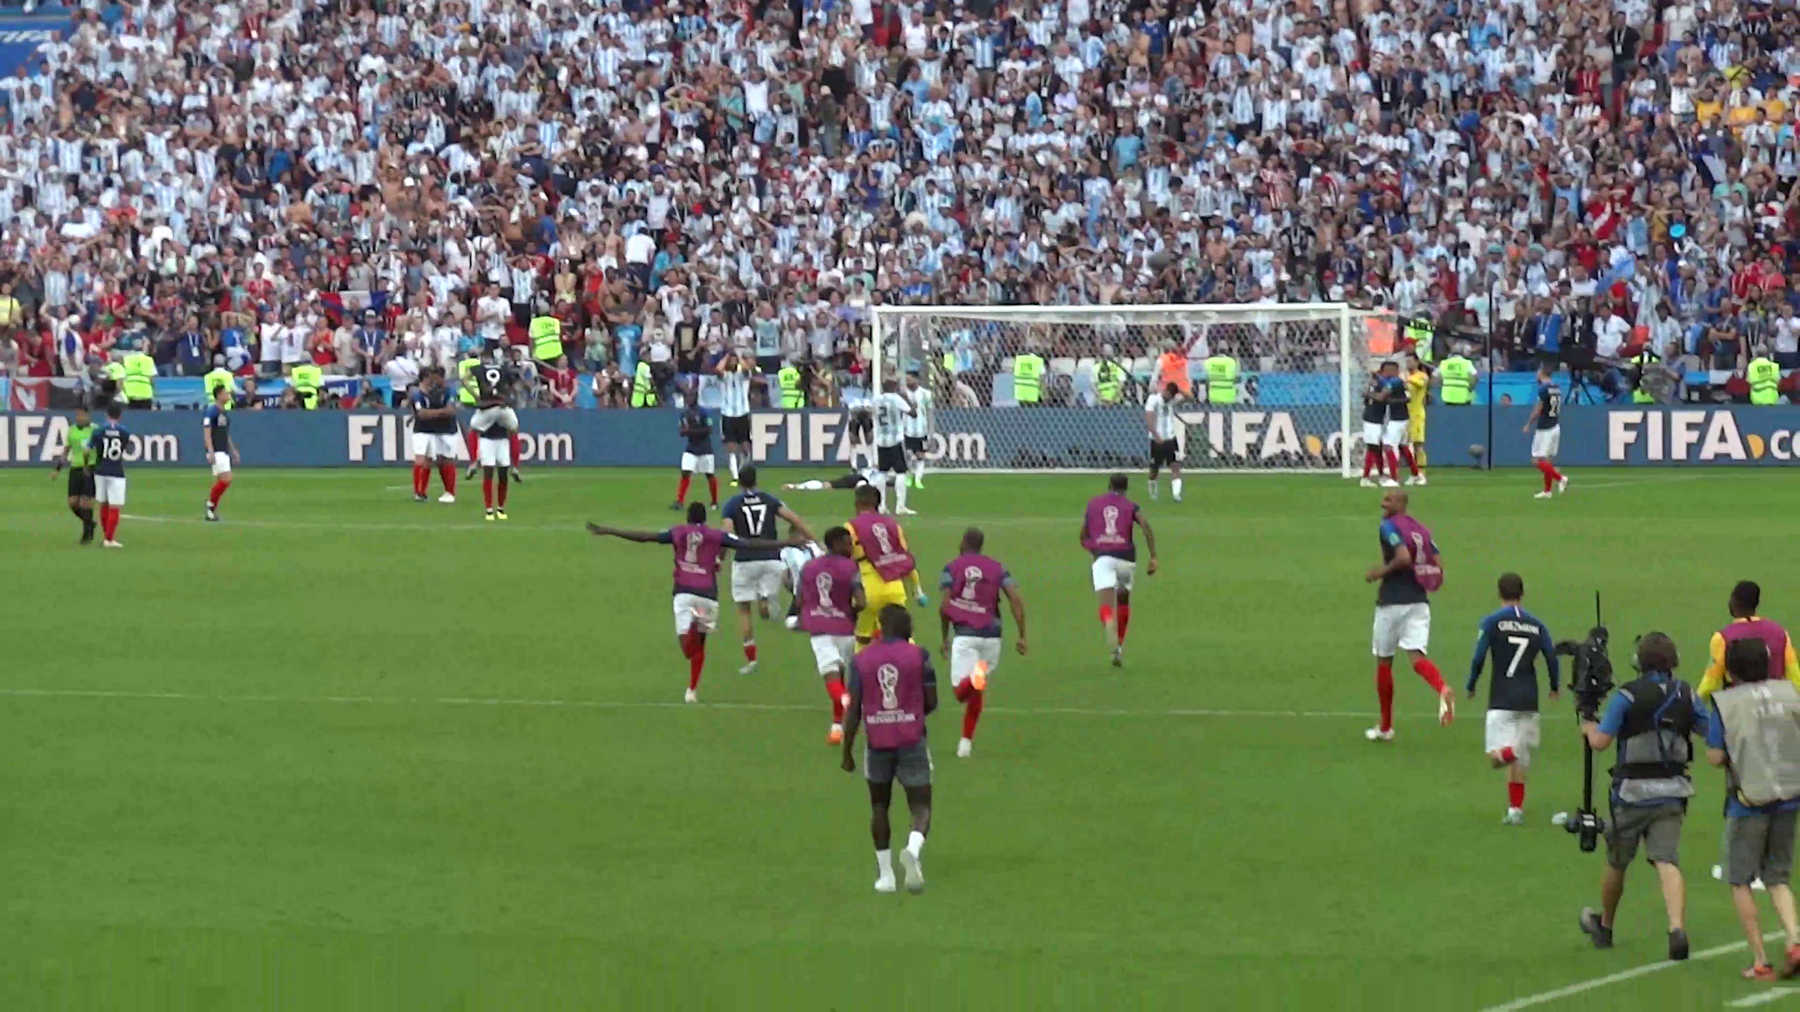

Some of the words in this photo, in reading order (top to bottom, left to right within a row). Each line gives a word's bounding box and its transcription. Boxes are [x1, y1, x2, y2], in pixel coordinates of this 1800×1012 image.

[486, 369, 500, 387] 9
[102, 437, 122, 460] 18
[742, 504, 767, 536] 17
[1506, 636, 1529, 678] 7
